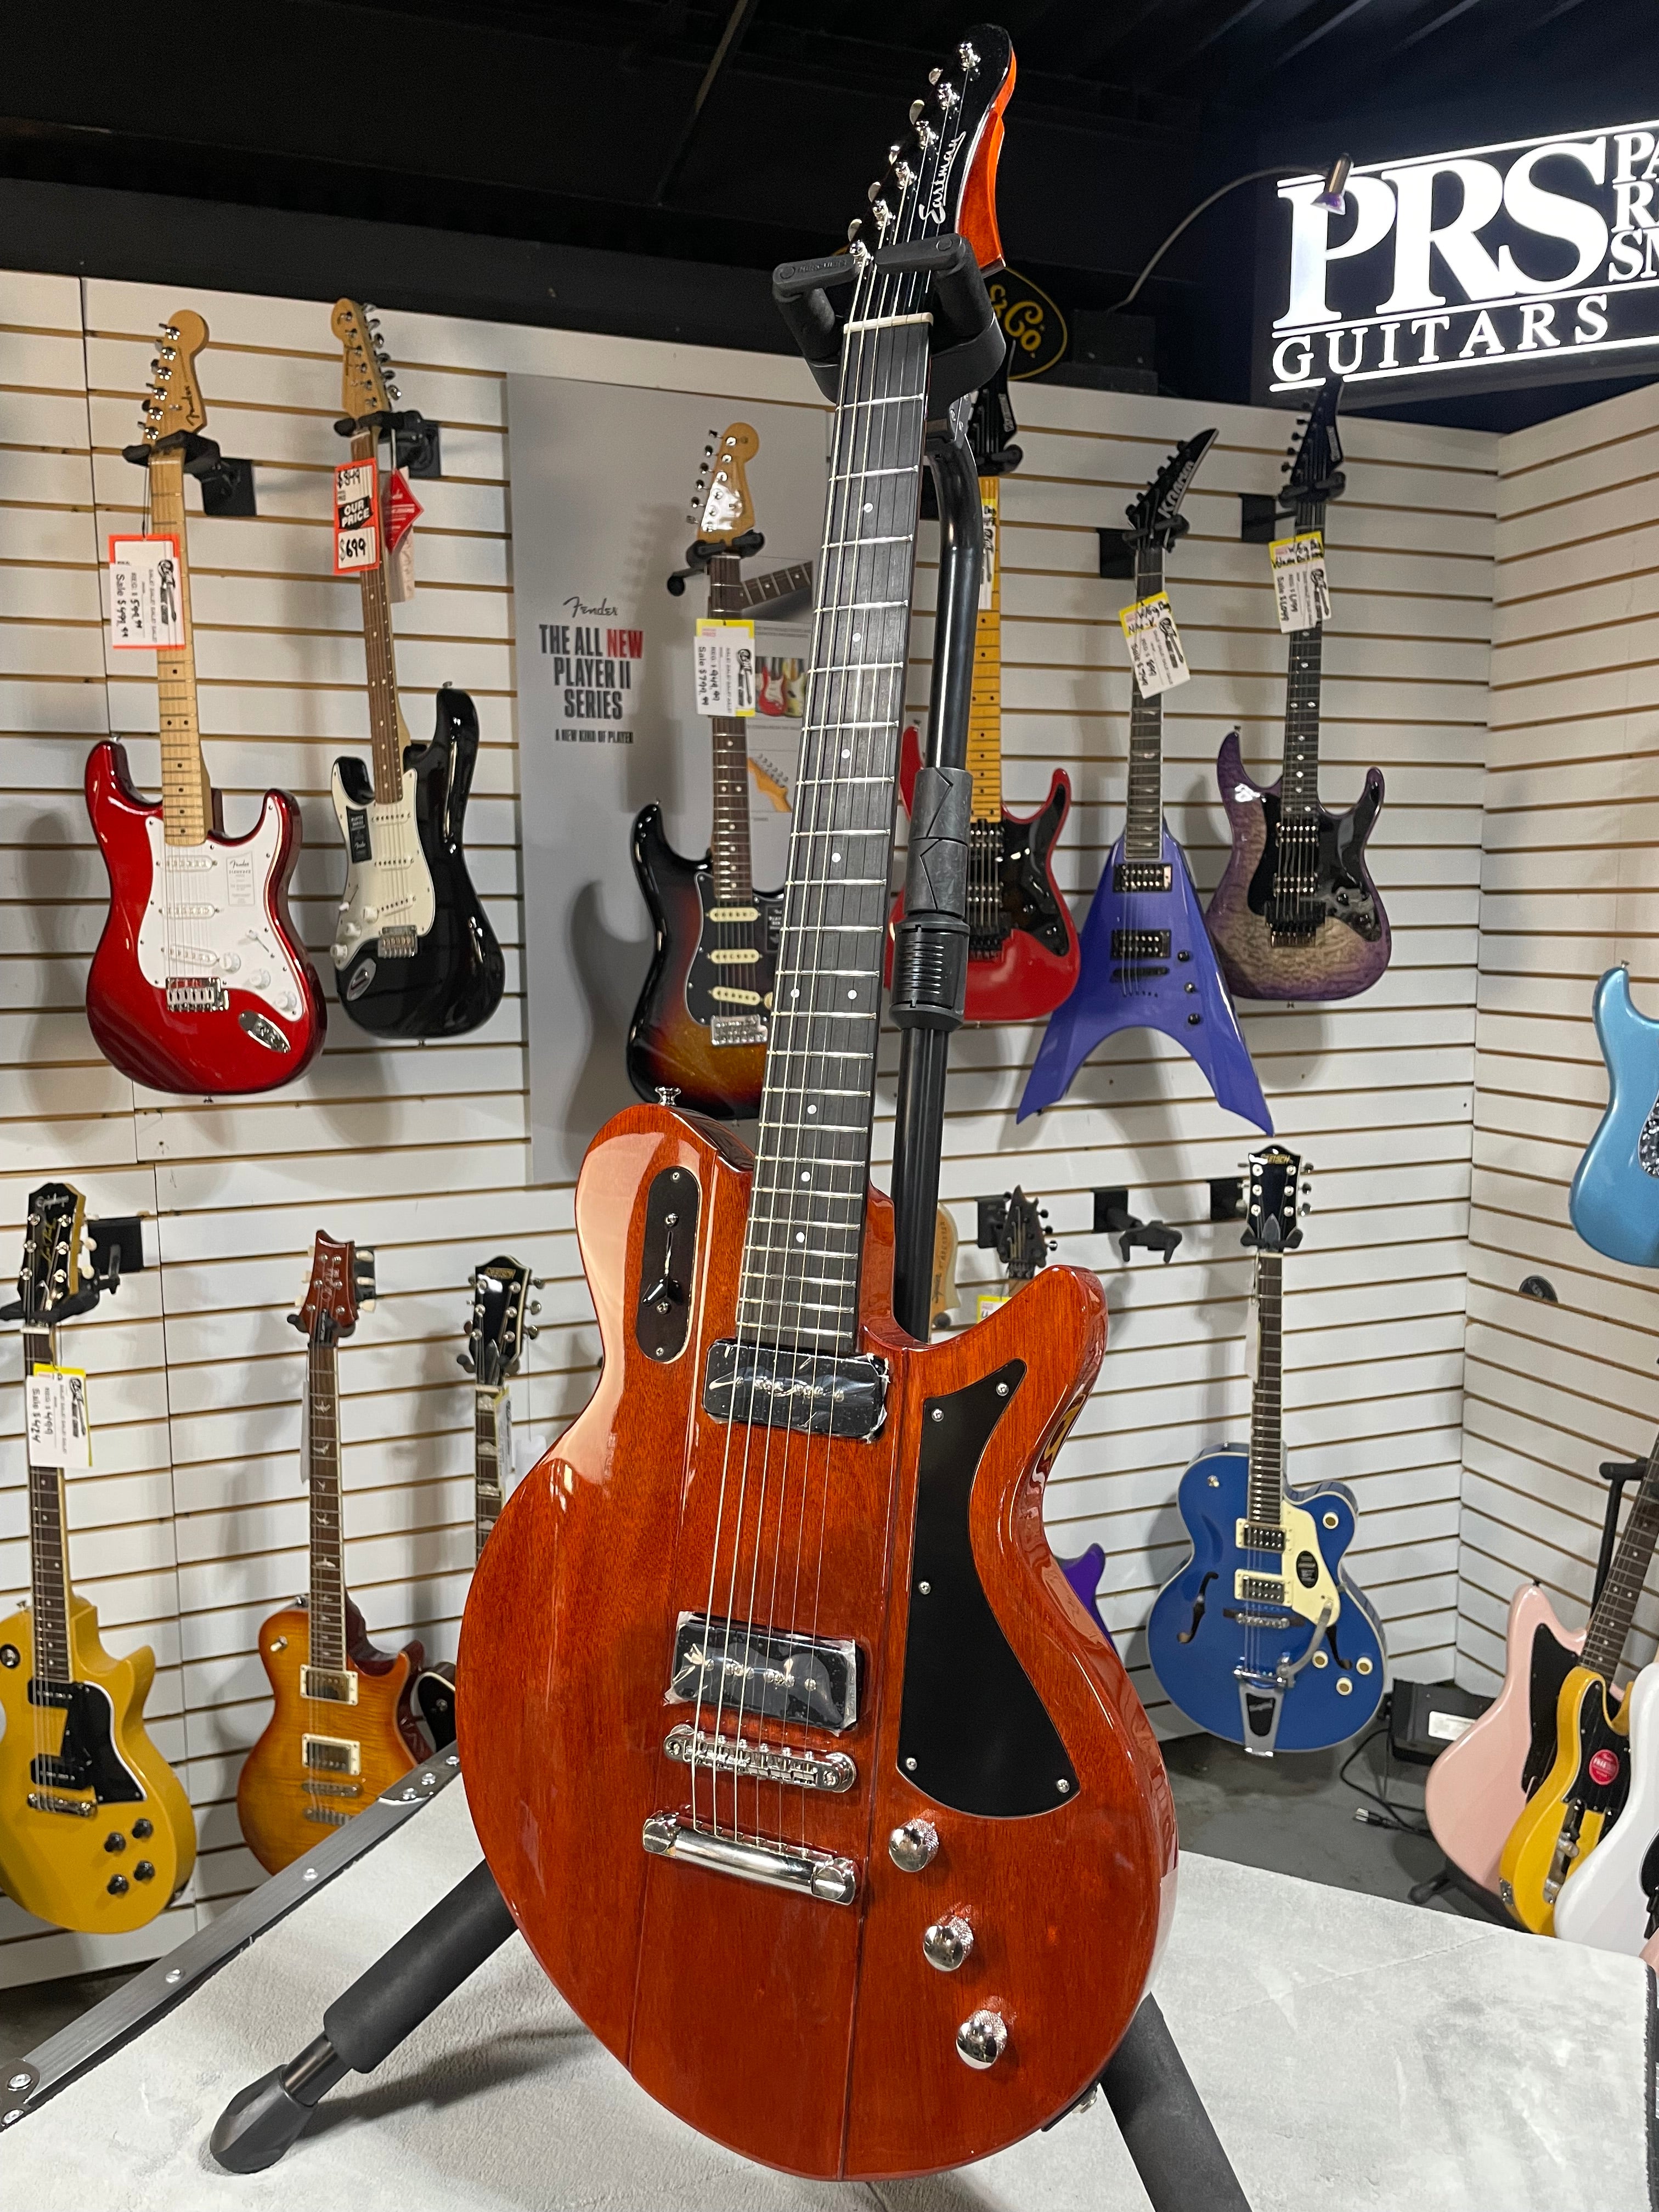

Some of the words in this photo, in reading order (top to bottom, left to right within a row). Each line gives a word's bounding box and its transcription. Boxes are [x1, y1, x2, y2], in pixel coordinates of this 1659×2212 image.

[918, 131, 967, 224] Eastman
[1273, 136, 1609, 329] PRS
[1271, 294, 1609, 382] GUITARS
[341, 507, 370, 529] PRICE
[343, 499, 364, 516] OUR
[339, 537, 366, 563] $699
[563, 596, 619, 618] Fender
[539, 624, 571, 654] THE
[574, 627, 603, 657] ALL
[607, 628, 644, 659] NEW
[698, 647, 707, 666] Sale
[554, 657, 614, 689] PLAYER
[619, 661, 631, 690] II
[564, 691, 623, 720] SERIES
[561, 729, 578, 742] NEW
[579, 730, 596, 742] KIND
[608, 731, 634, 744] PLAYER
